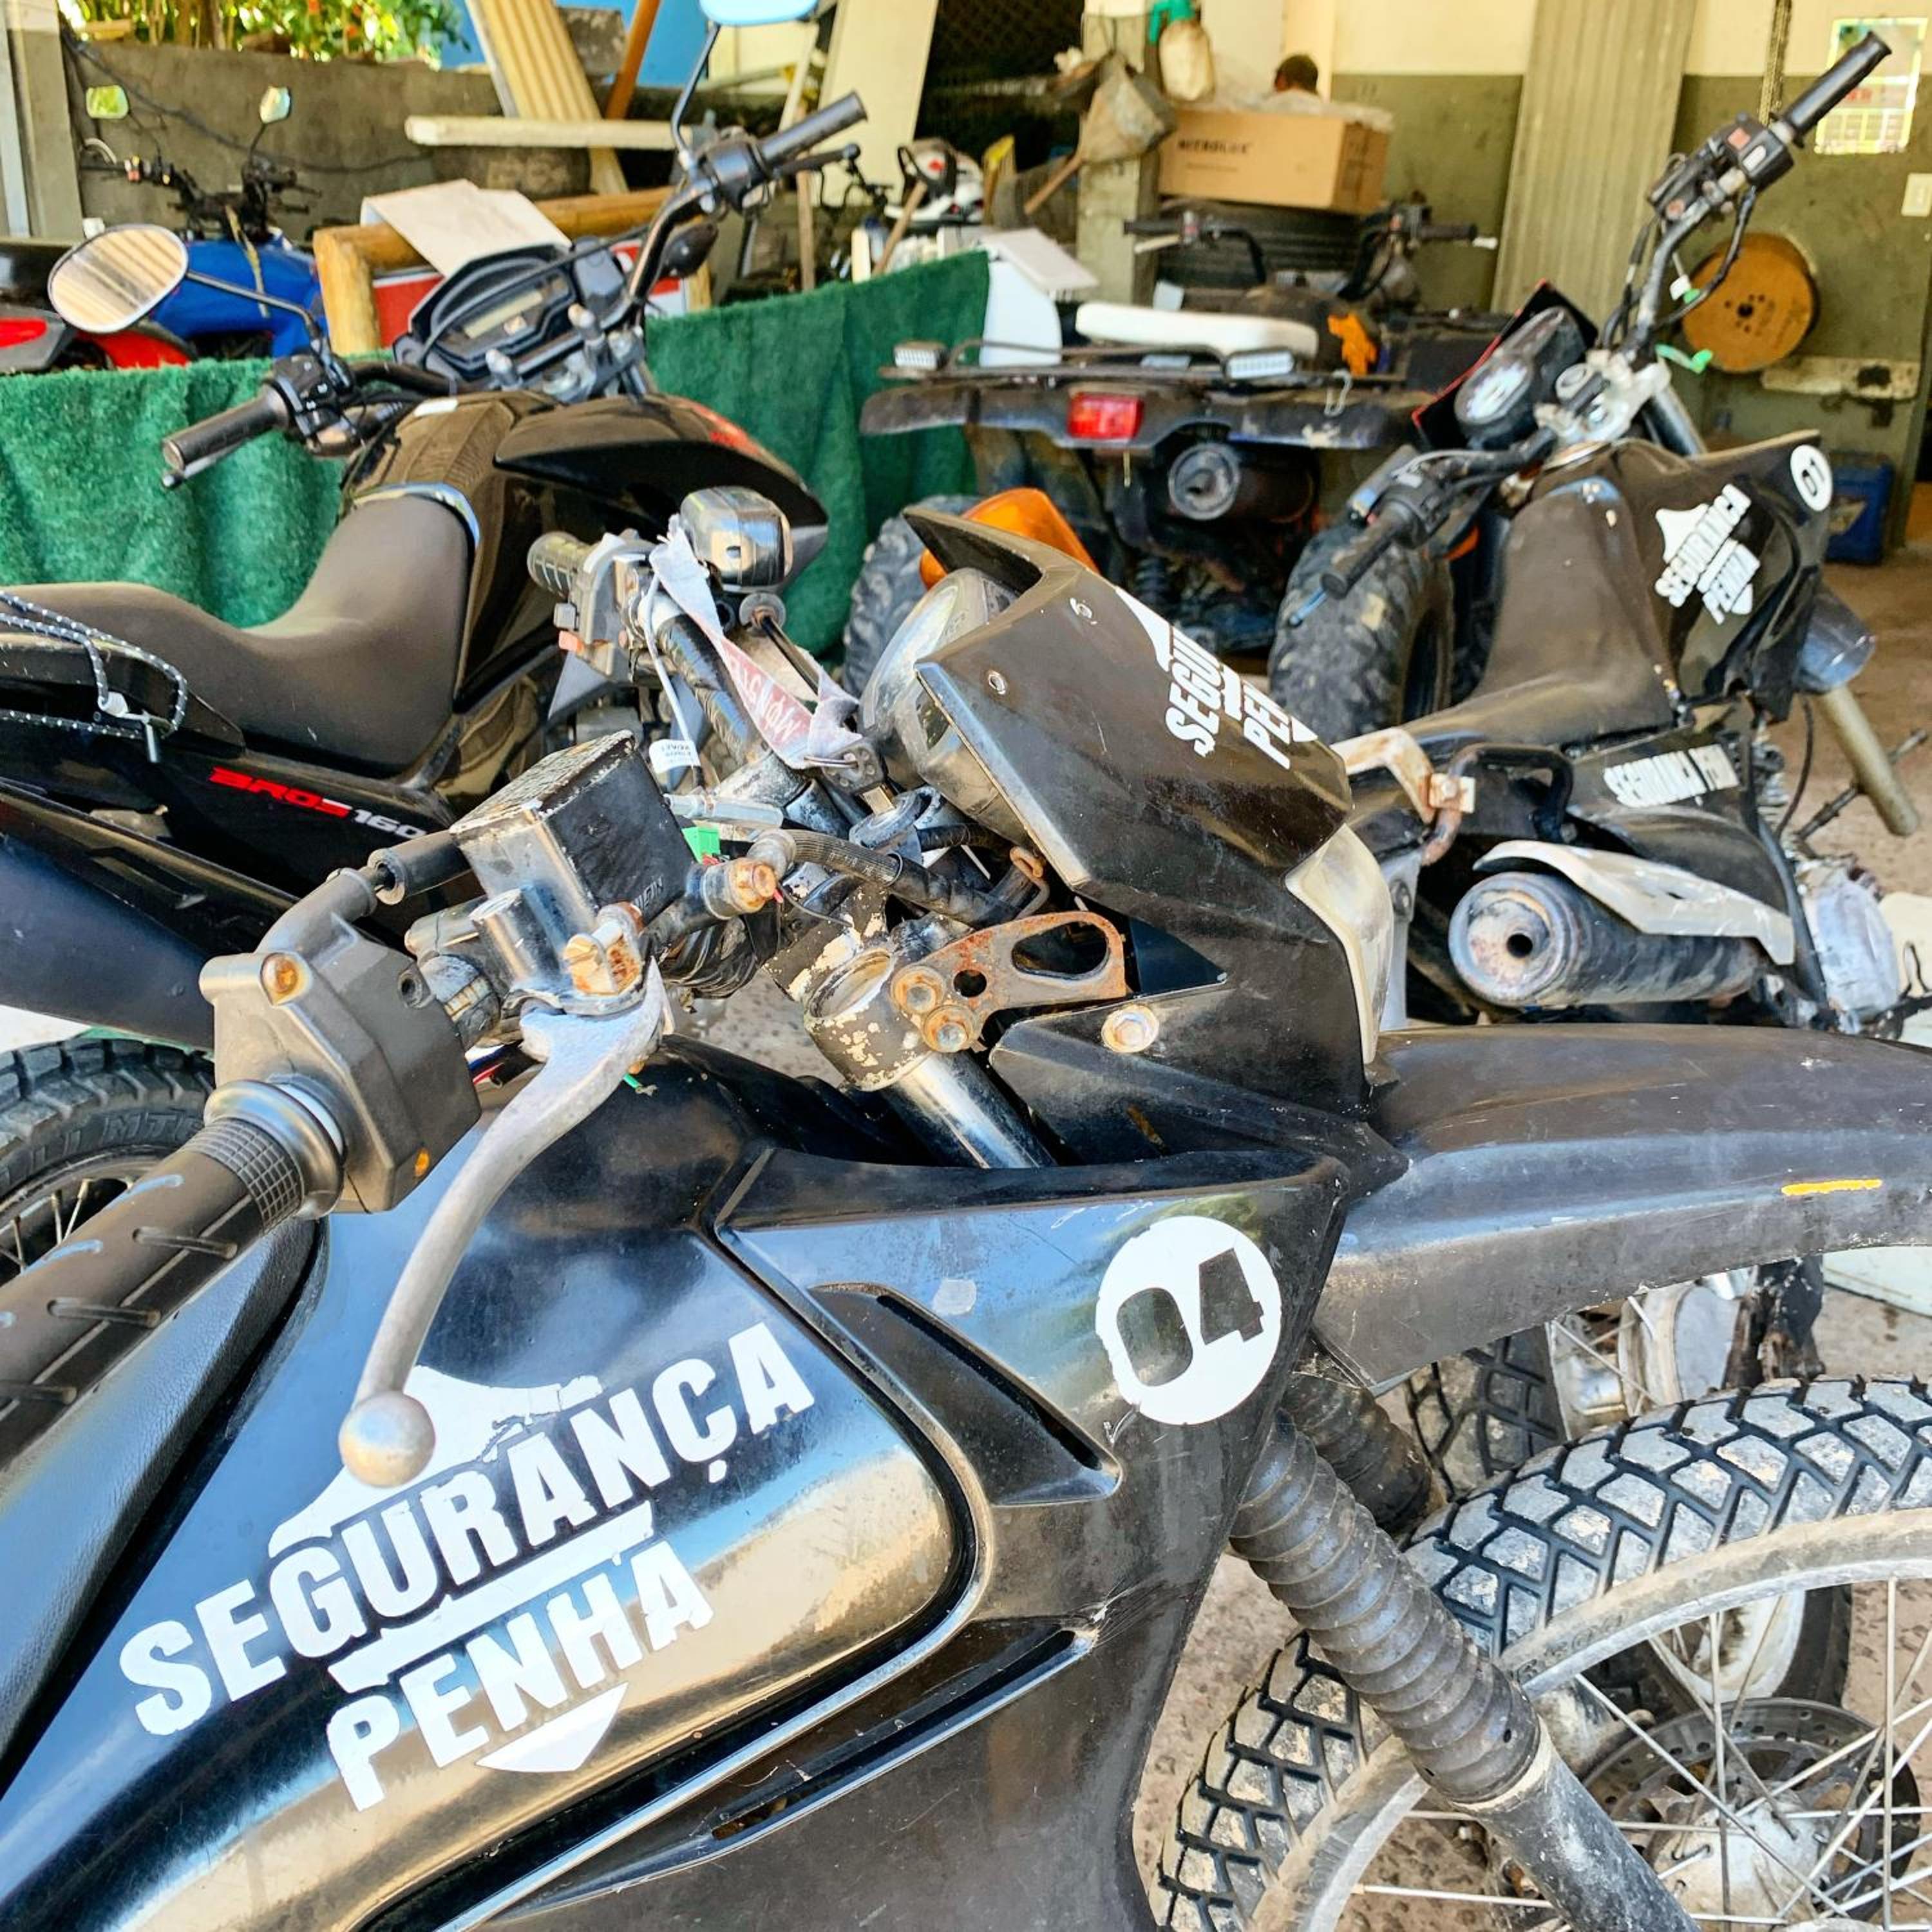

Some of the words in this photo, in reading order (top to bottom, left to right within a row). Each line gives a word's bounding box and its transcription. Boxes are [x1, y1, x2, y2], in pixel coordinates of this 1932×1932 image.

[1801, 458, 1825, 497] 01
[209, 766, 353, 819] BROS
[354, 808, 428, 840] 160
[1116, 1247, 1264, 1387] 04
[118, 1321, 816, 1736] SEGURANÇA
[327, 1540, 714, 1812] PENHA
